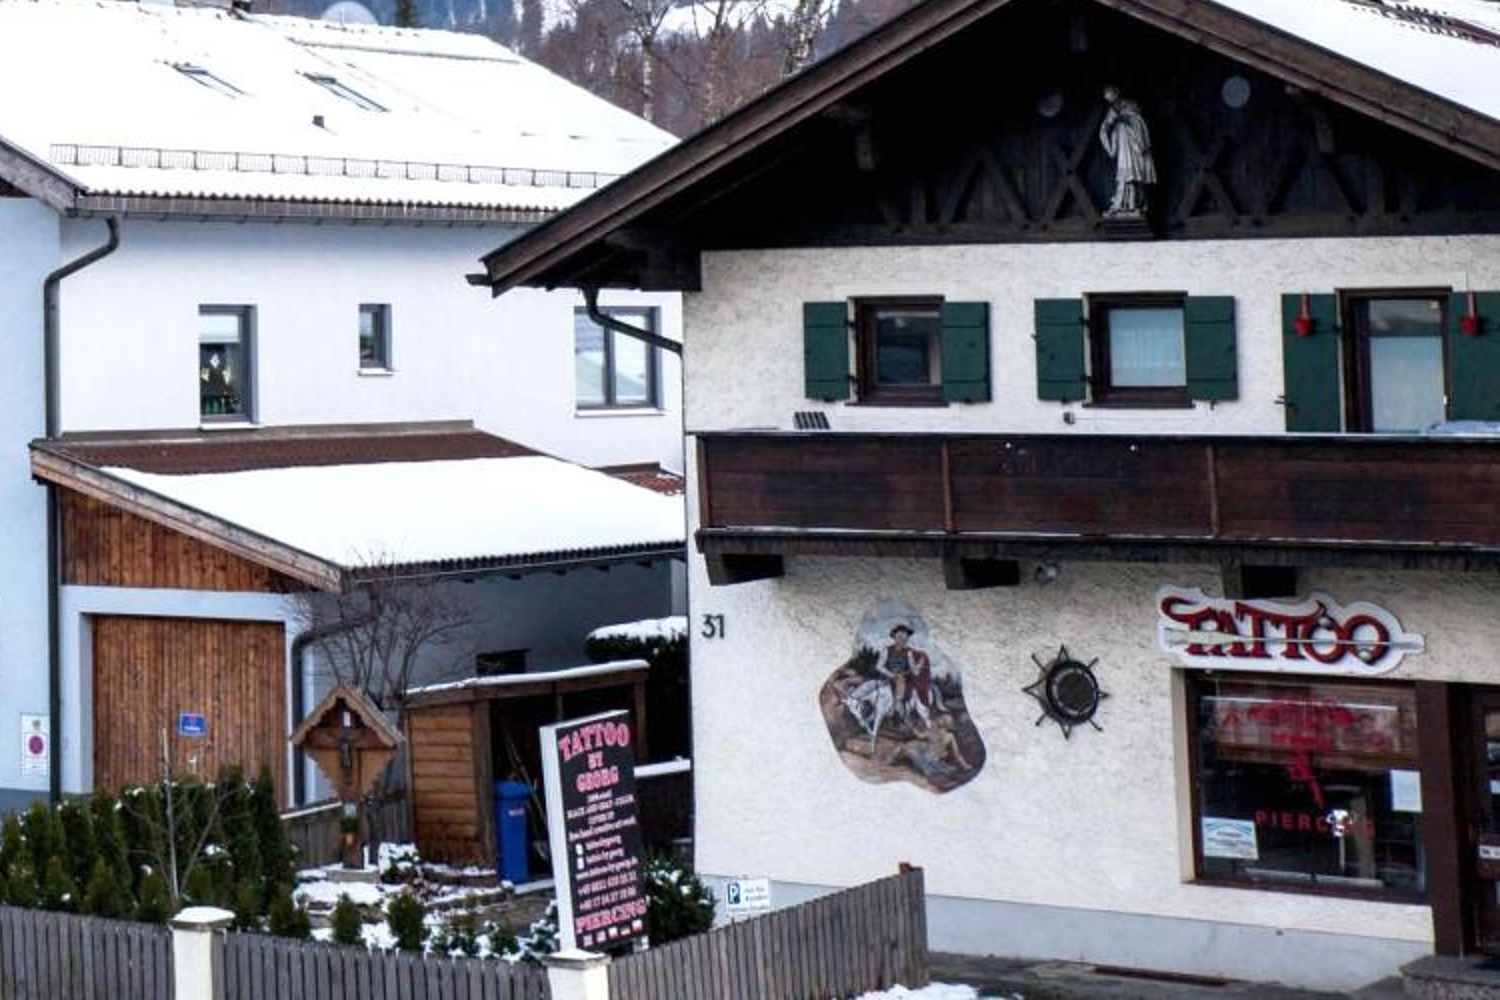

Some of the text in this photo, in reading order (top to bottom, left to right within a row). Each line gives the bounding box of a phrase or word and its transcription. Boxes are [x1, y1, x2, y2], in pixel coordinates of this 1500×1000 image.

[701, 613, 725, 640] 31
[1160, 596, 1391, 666] TATTOO
[558, 721, 631, 761] TATTOO
